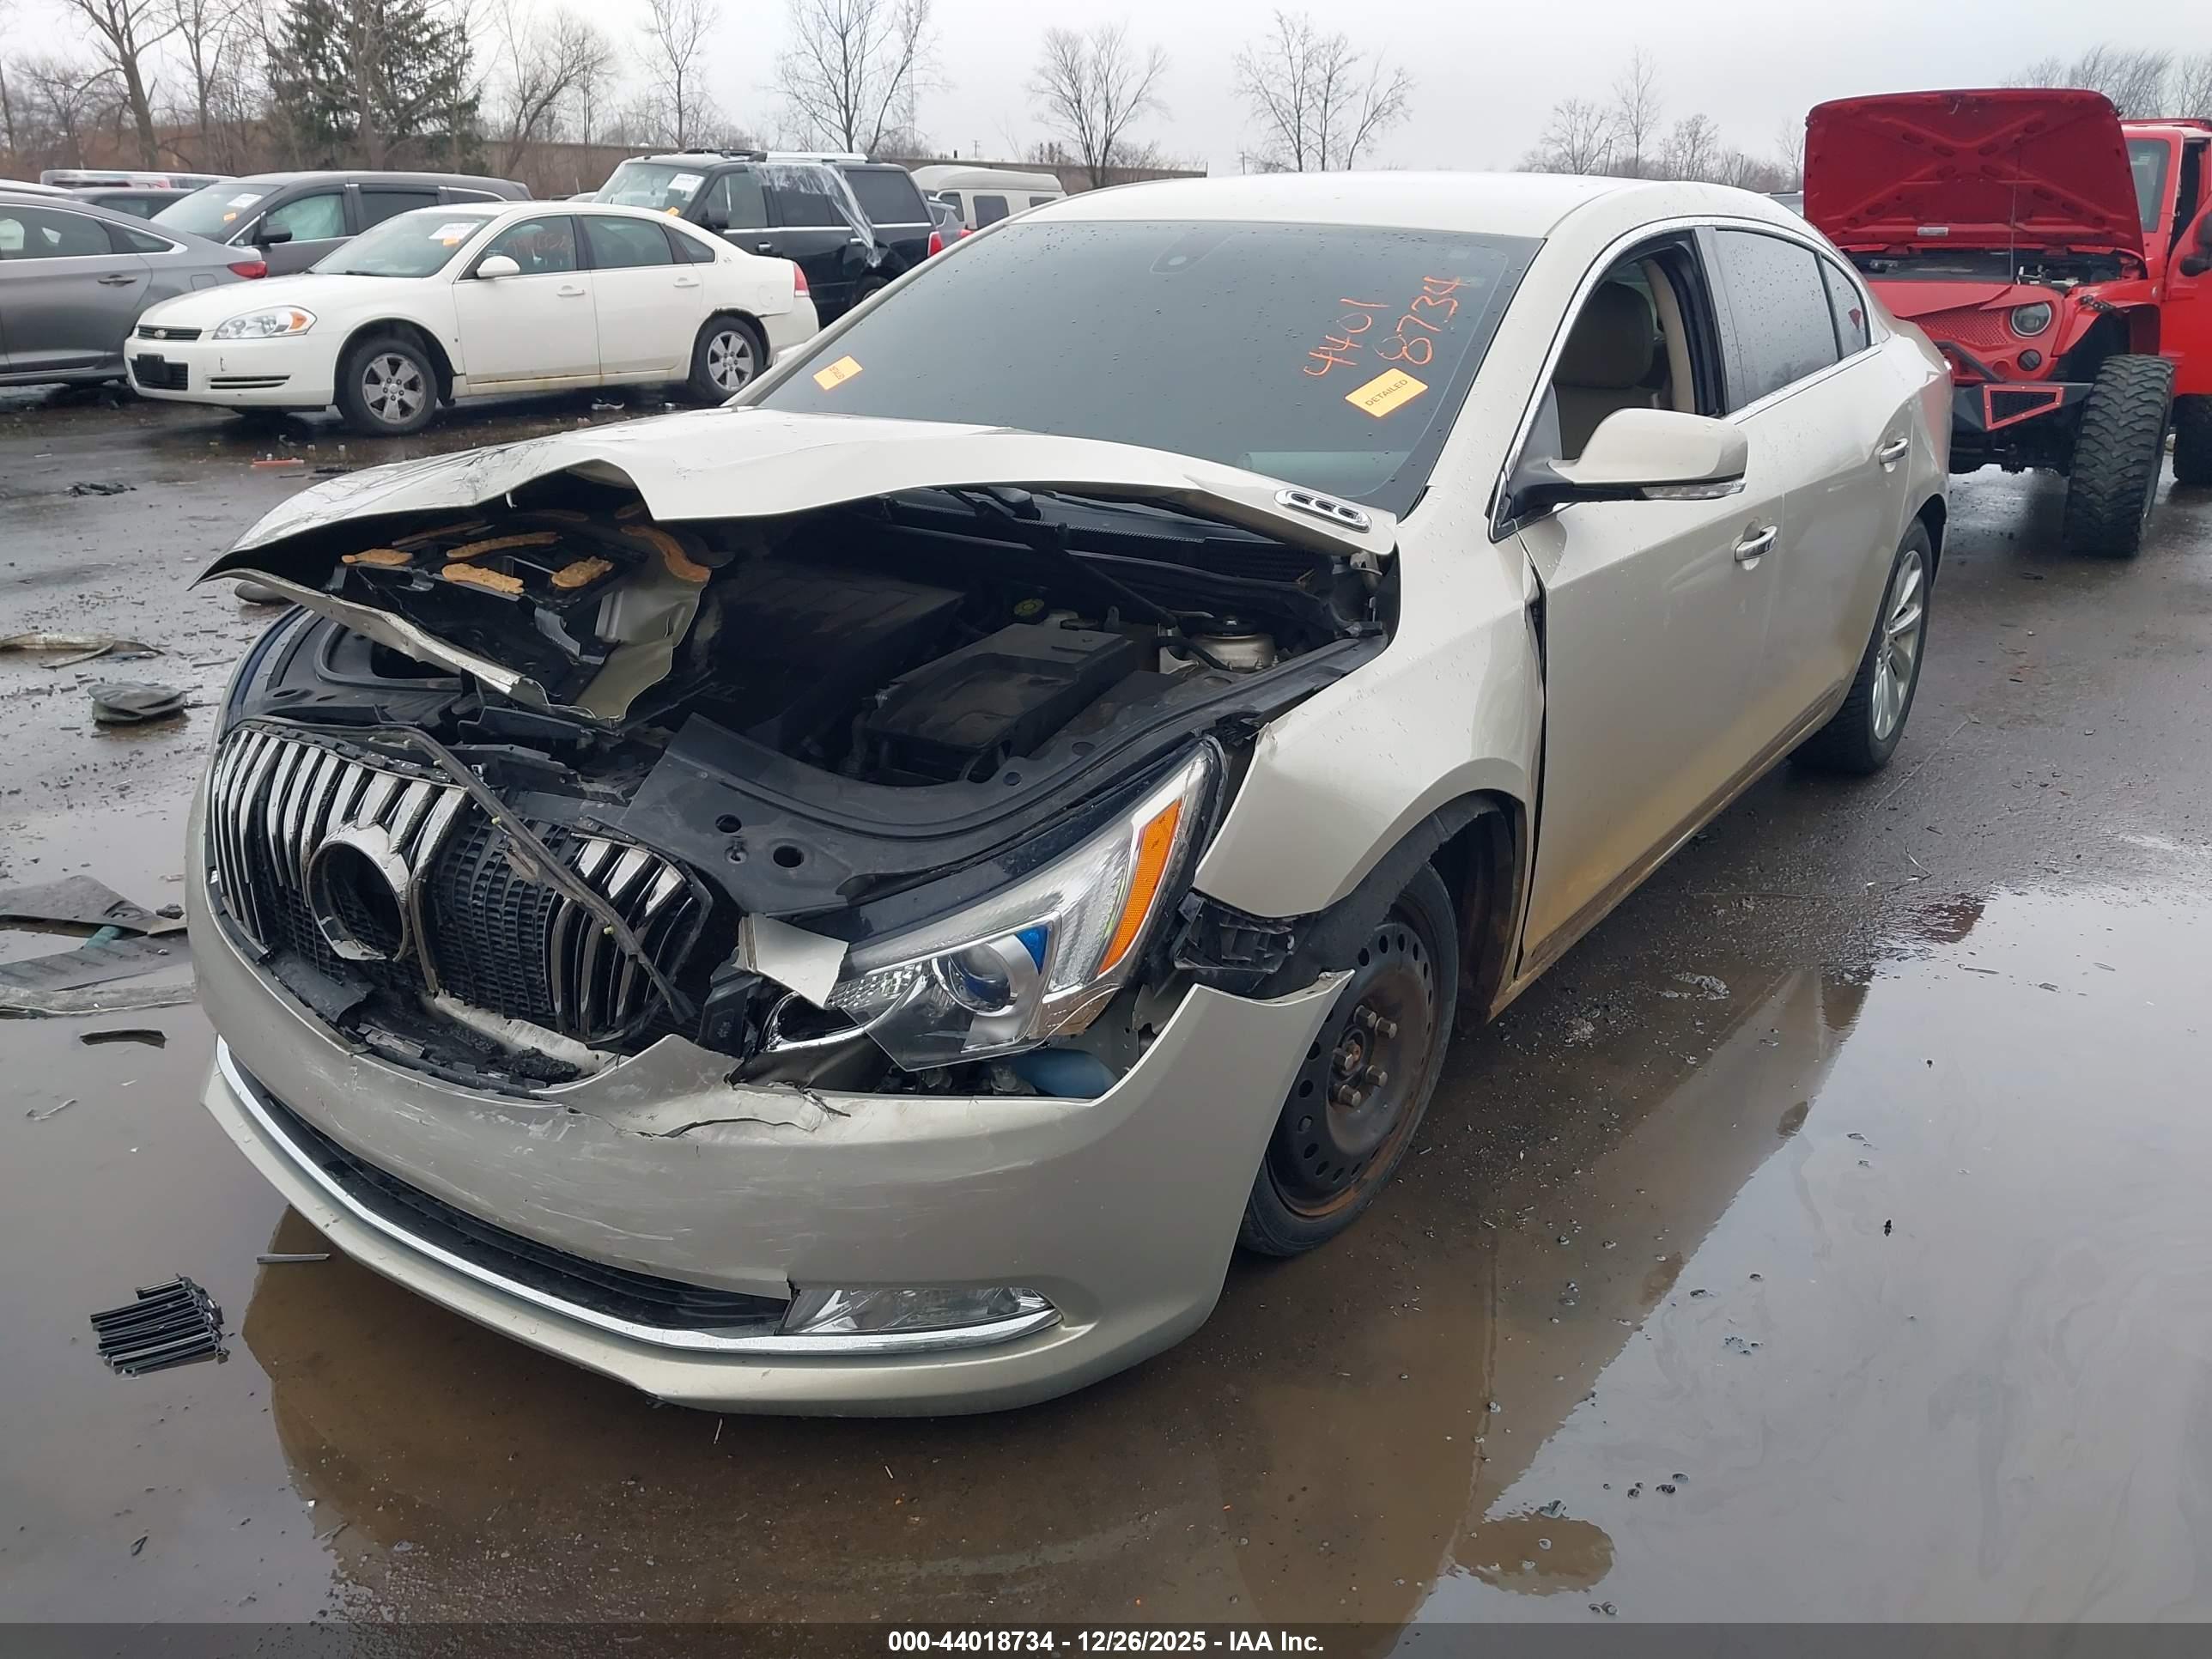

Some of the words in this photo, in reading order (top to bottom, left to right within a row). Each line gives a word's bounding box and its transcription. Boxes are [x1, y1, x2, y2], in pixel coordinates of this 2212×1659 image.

[1303, 298, 1393, 376] 4401
[1372, 275, 1472, 366] 8734
[1364, 379, 1408, 406] DETAILED
